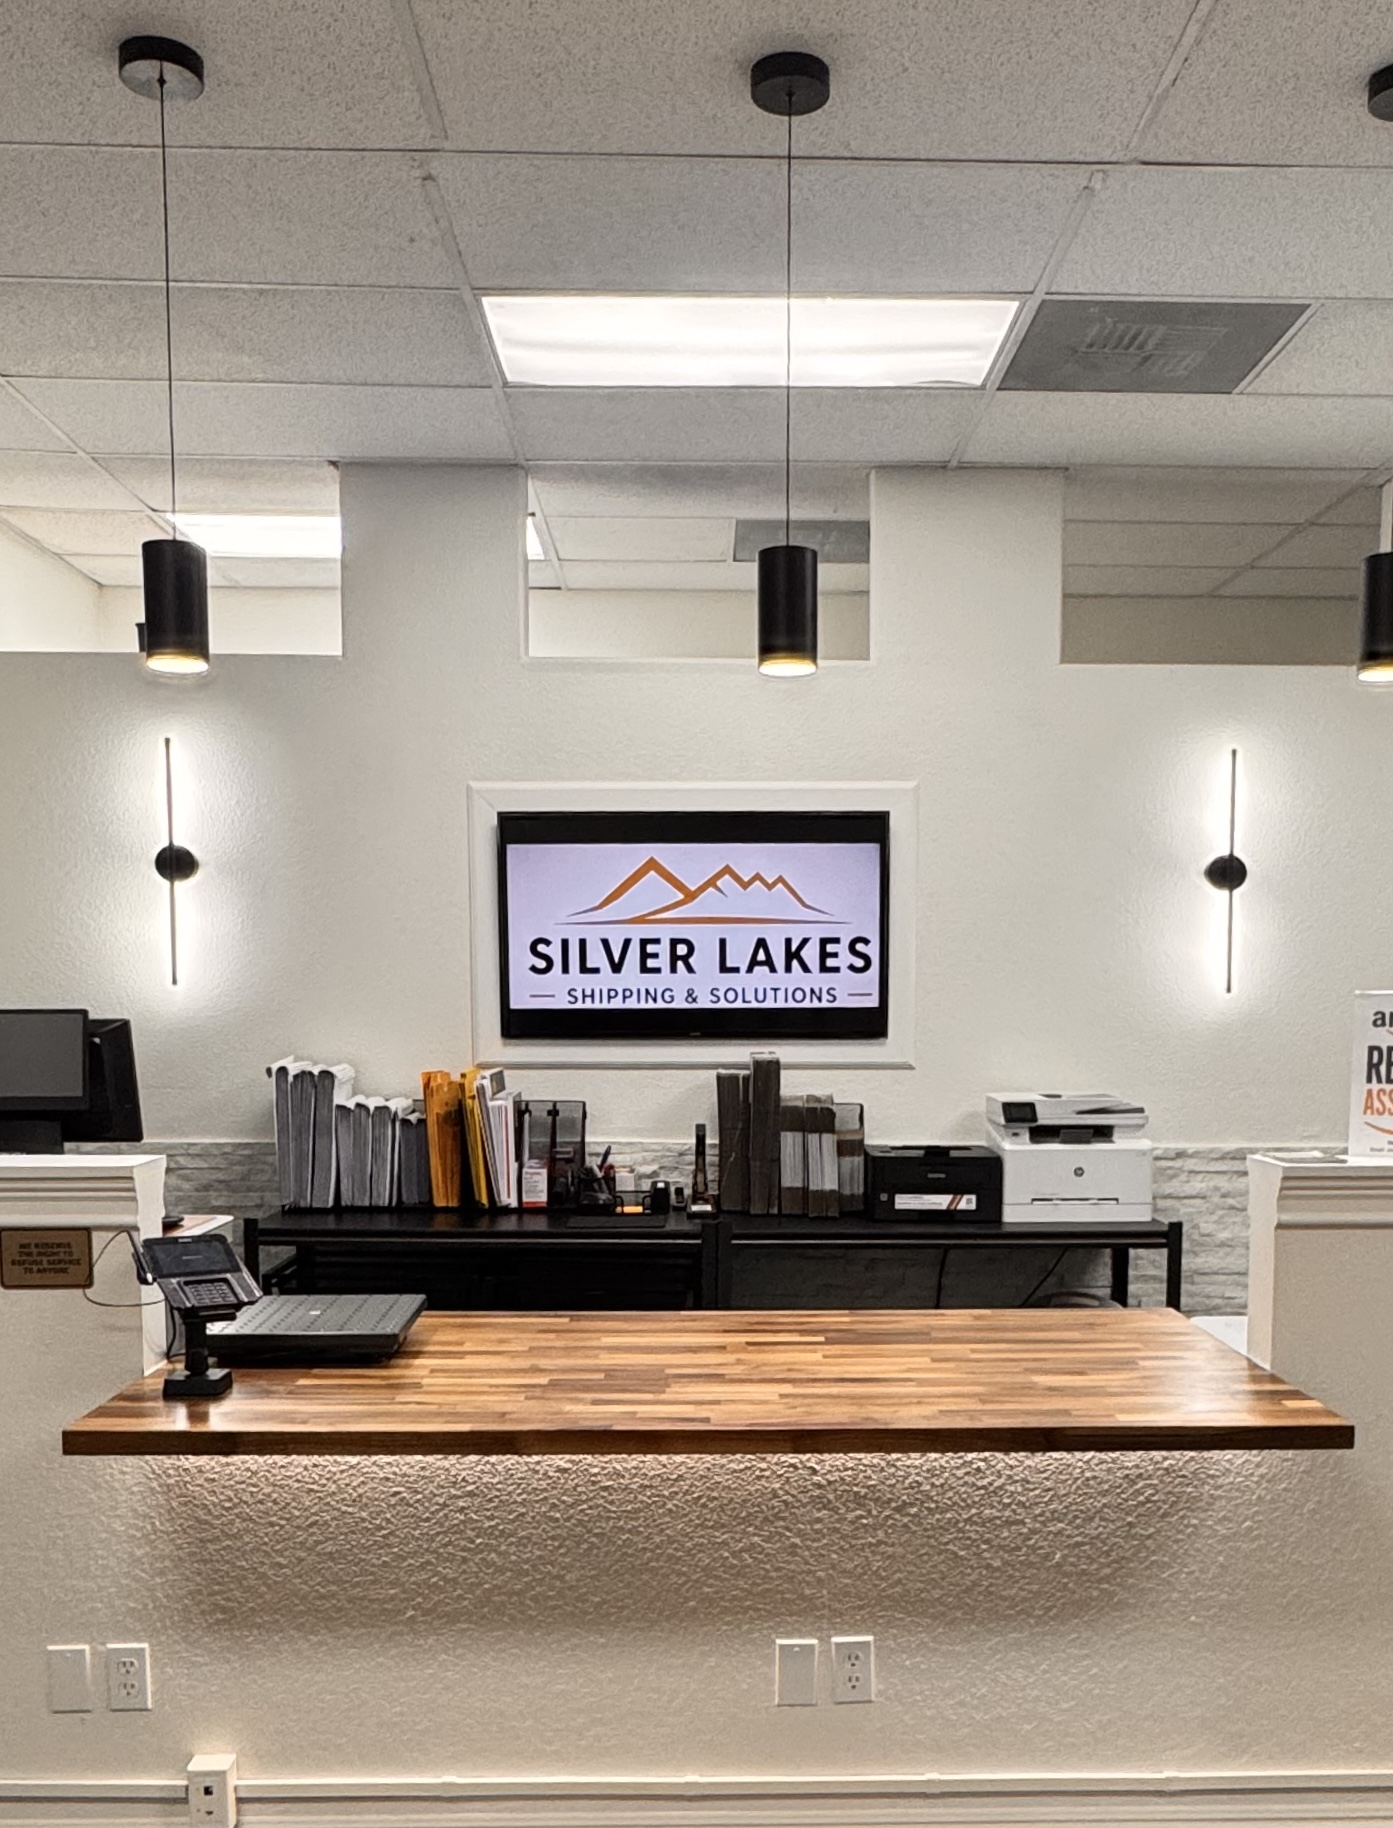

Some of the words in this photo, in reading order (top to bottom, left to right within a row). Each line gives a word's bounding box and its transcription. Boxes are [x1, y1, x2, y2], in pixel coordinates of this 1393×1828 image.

[528, 936, 697, 976] SILVER
[718, 936, 873, 975] LAKES
[566, 987, 676, 1005] SHIPPING
[684, 987, 699, 1005] &
[708, 987, 838, 1004] SOLUTIONS
